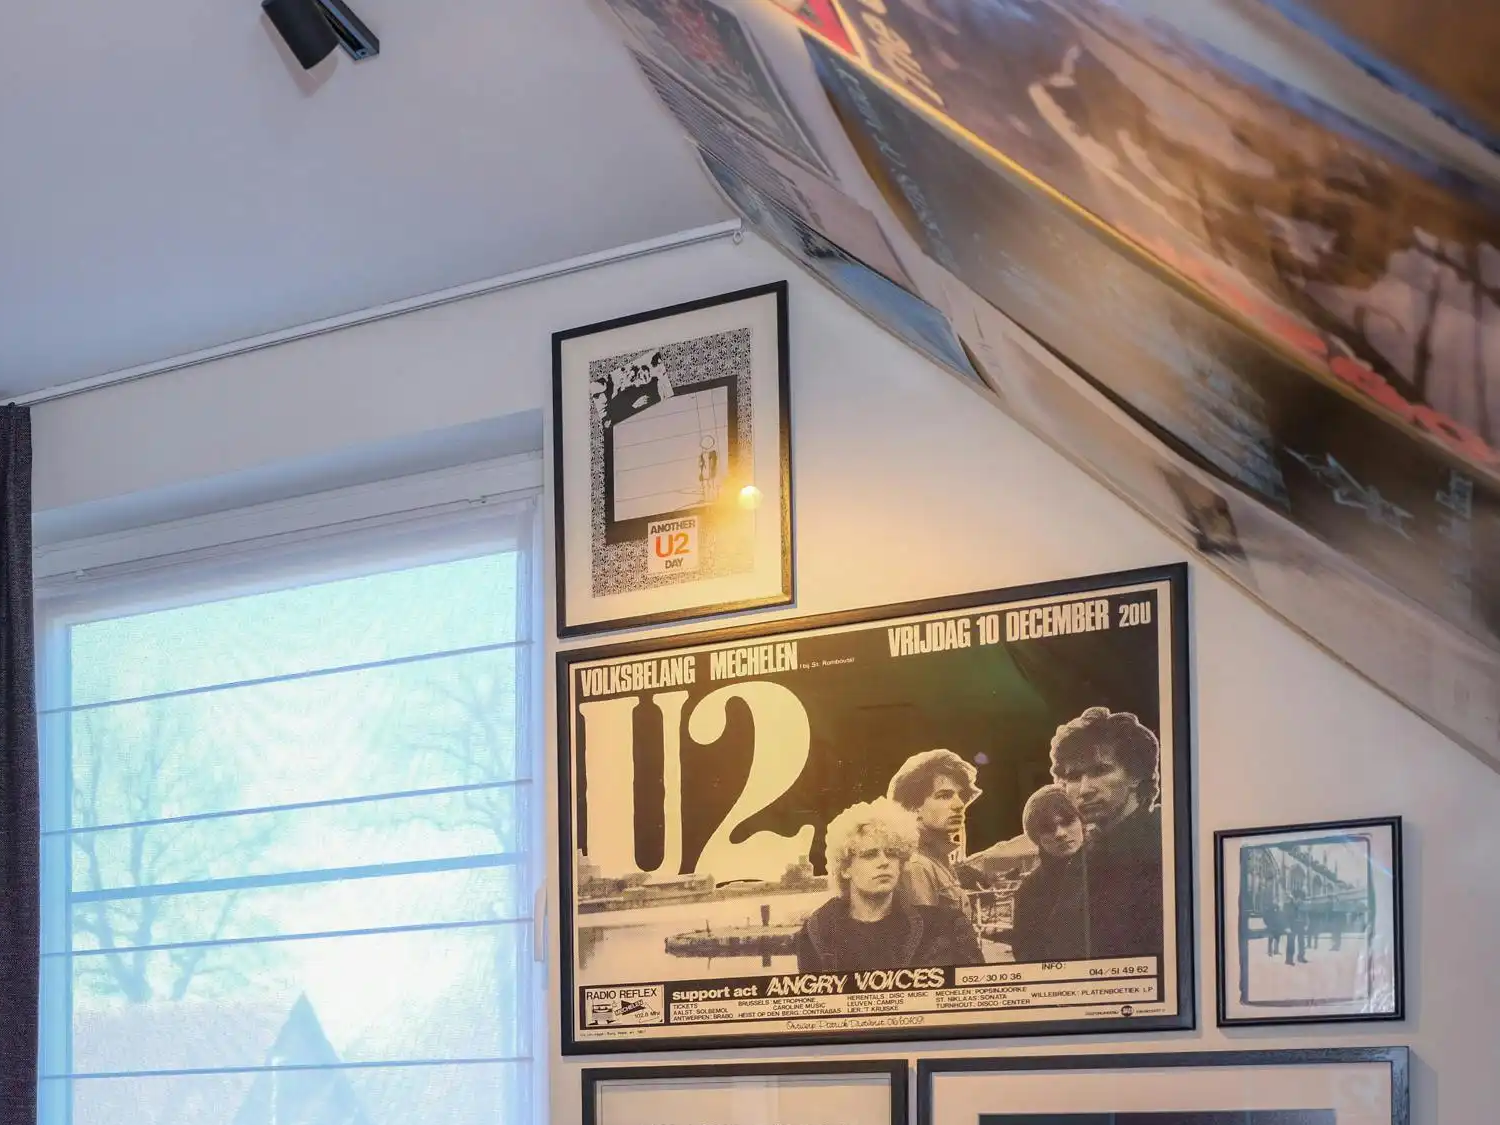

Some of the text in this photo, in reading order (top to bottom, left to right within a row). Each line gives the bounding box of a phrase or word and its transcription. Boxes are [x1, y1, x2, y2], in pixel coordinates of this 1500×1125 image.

[650, 519, 696, 535] ANOTHER
[655, 532, 690, 558] U2
[665, 557, 684, 570] DAY
[888, 599, 1151, 657] VRIJDAG 10 DECEMBER 20U
[581, 641, 798, 697] VOLKSBELANG MECHELEN
[579, 679, 815, 889] U2
[586, 987, 658, 1001] RADIO REFLEX
[672, 966, 945, 1003] support act ANGRY VOICES
